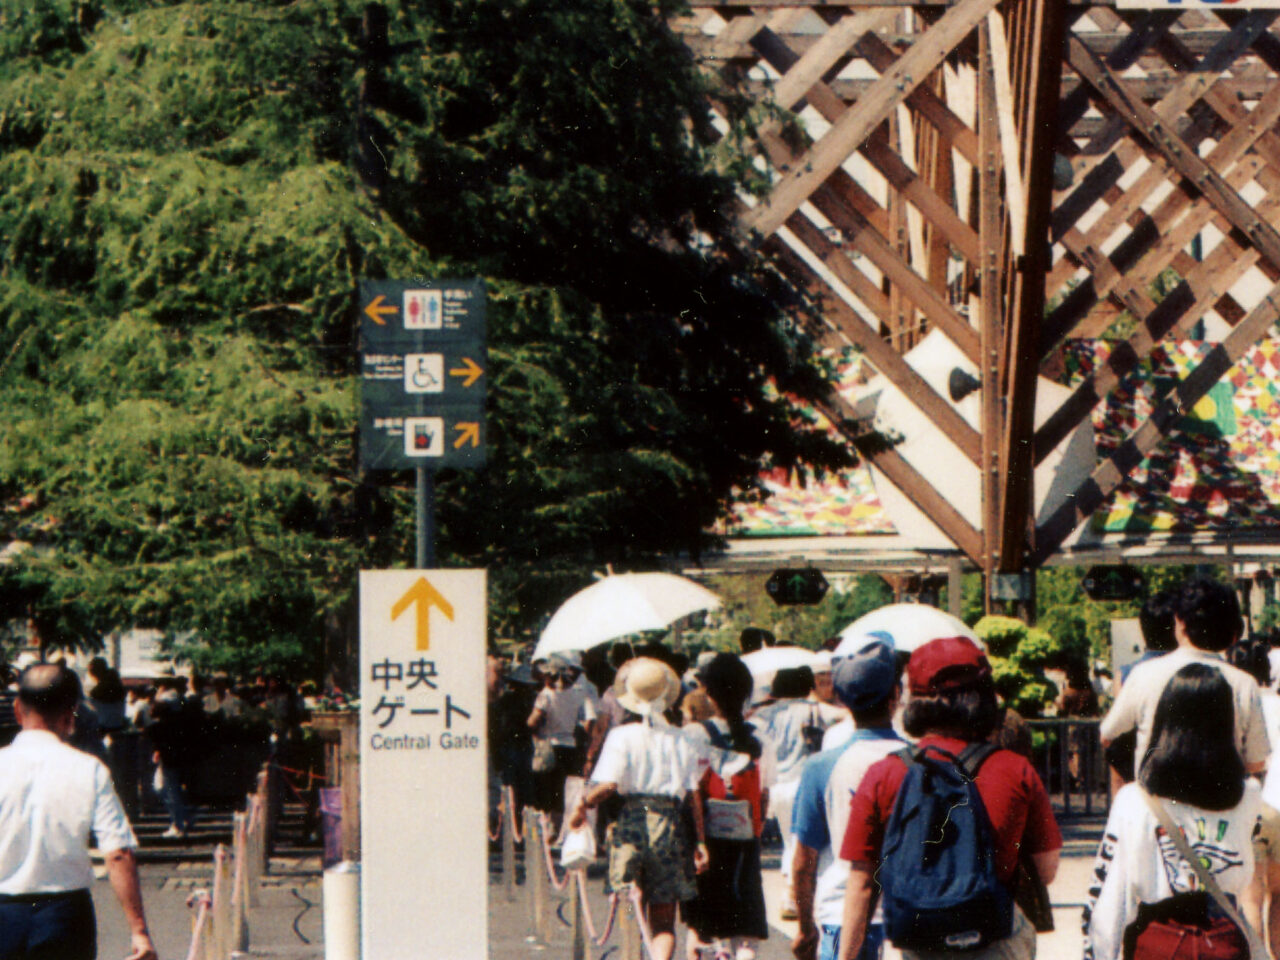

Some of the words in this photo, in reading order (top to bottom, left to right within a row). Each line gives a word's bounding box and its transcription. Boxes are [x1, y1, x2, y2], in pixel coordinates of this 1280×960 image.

[371, 658, 438, 690] 中央
[372, 695, 471, 728] ゲート
[371, 733, 431, 750] Central
[440, 732, 479, 749] Gate
